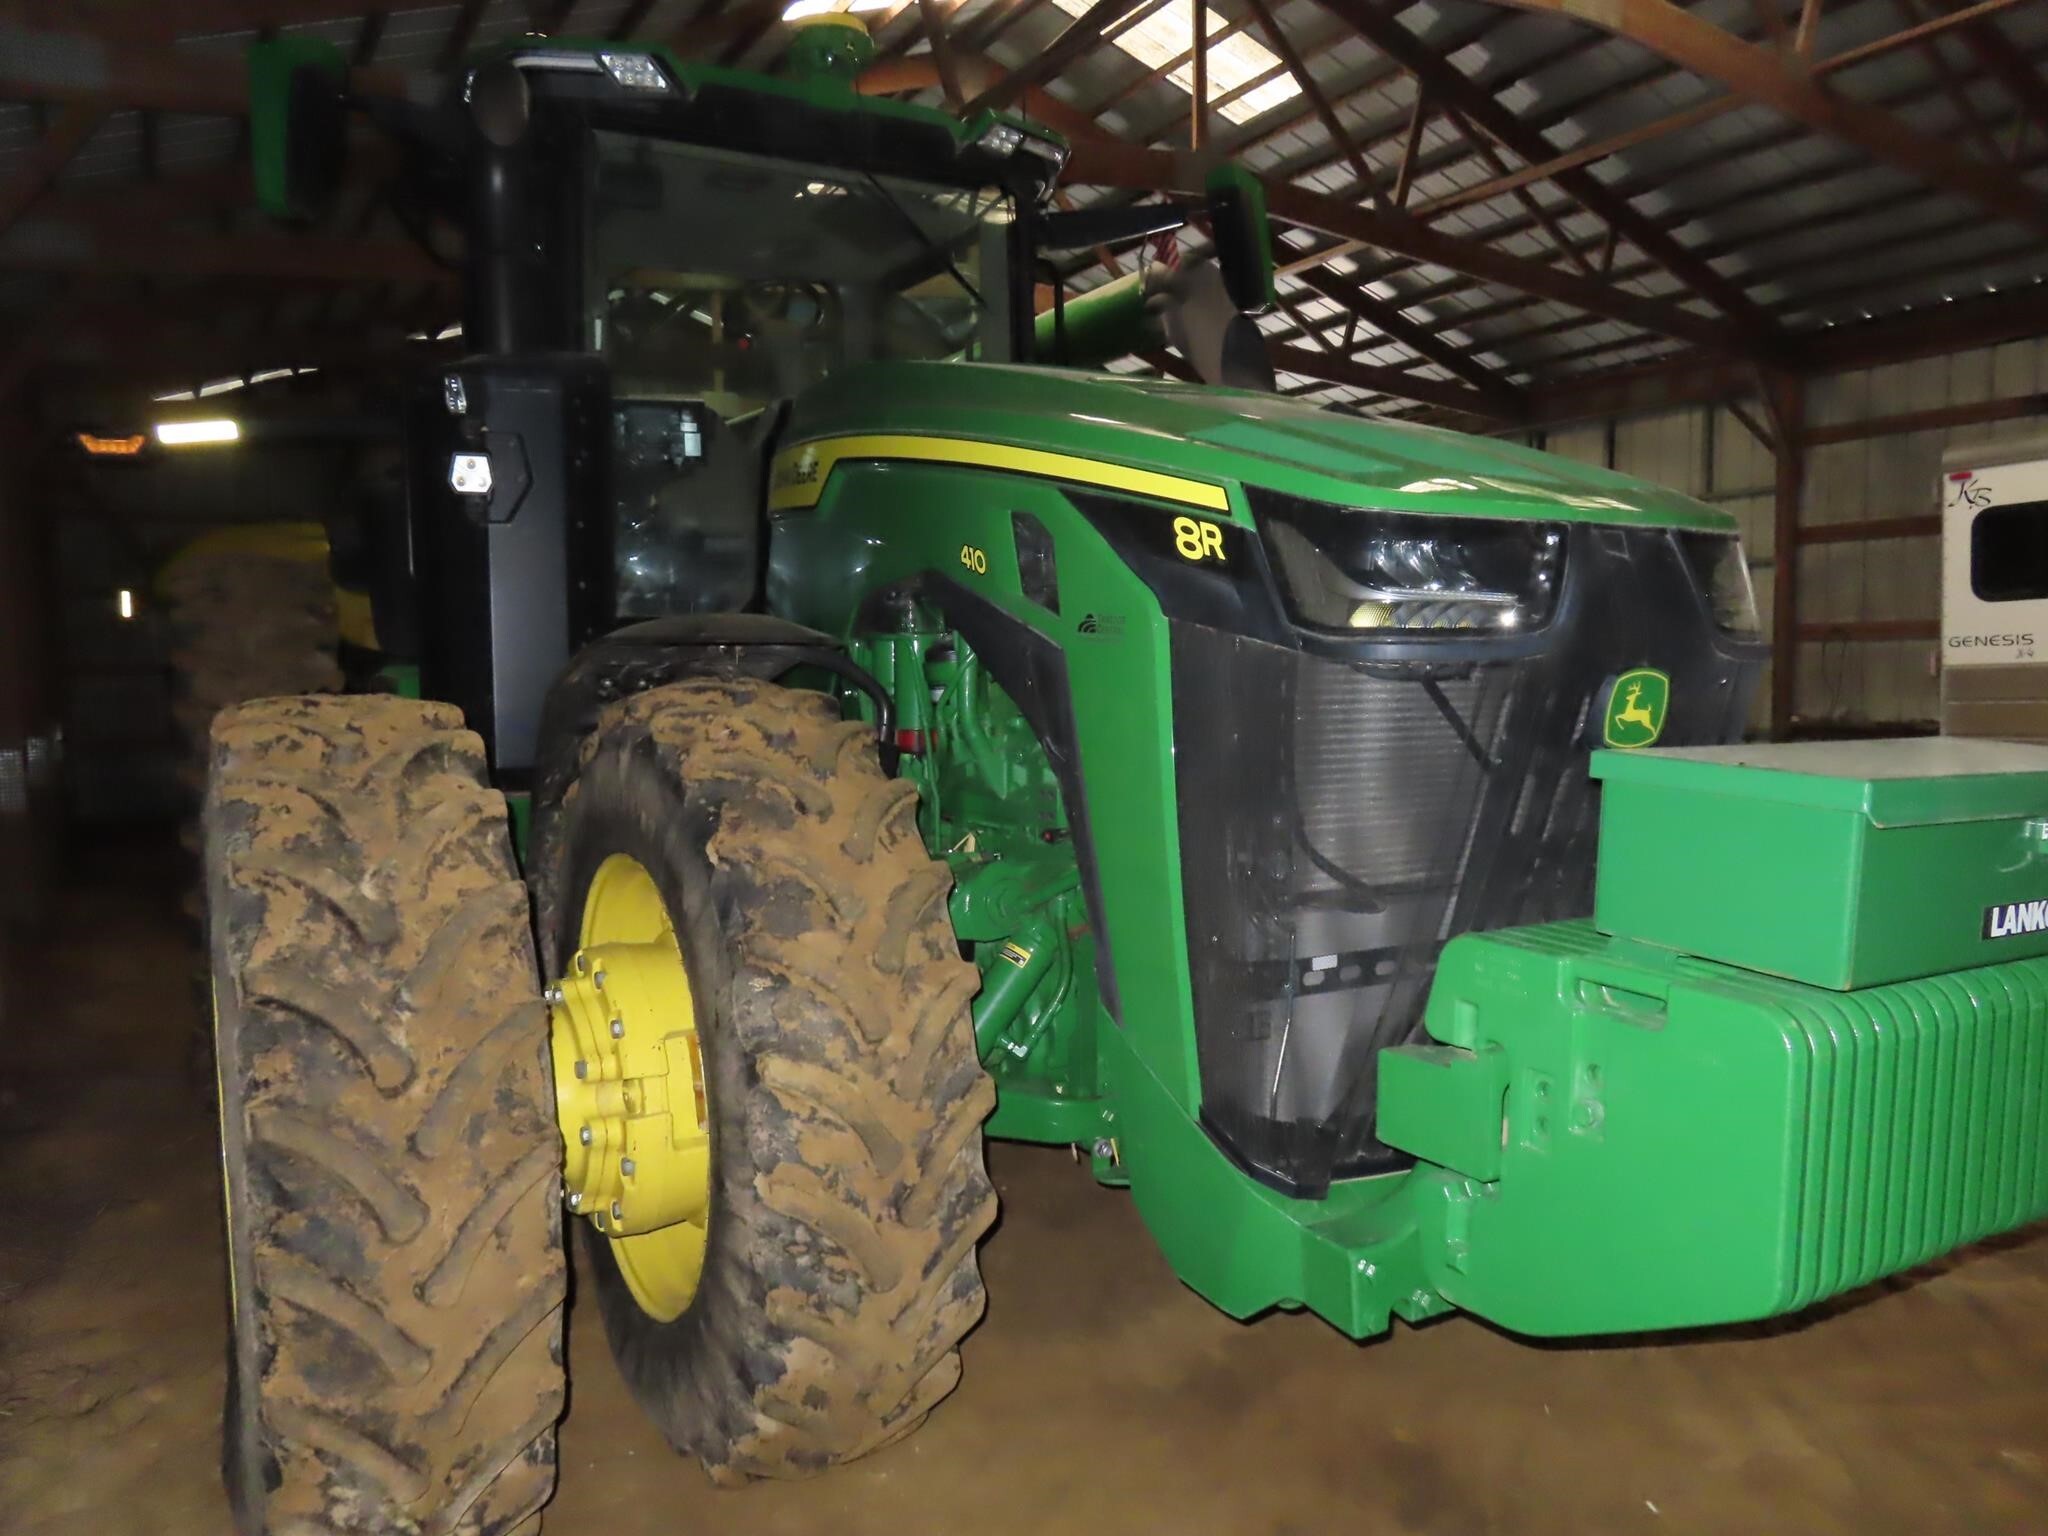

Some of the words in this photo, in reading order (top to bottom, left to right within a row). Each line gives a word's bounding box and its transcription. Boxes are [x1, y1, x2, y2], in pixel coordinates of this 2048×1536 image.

[1173, 516, 1226, 561] 8R
[960, 544, 986, 575] 410
[1948, 633, 2034, 648] GENESIS
[1990, 900, 2048, 938] LANK
